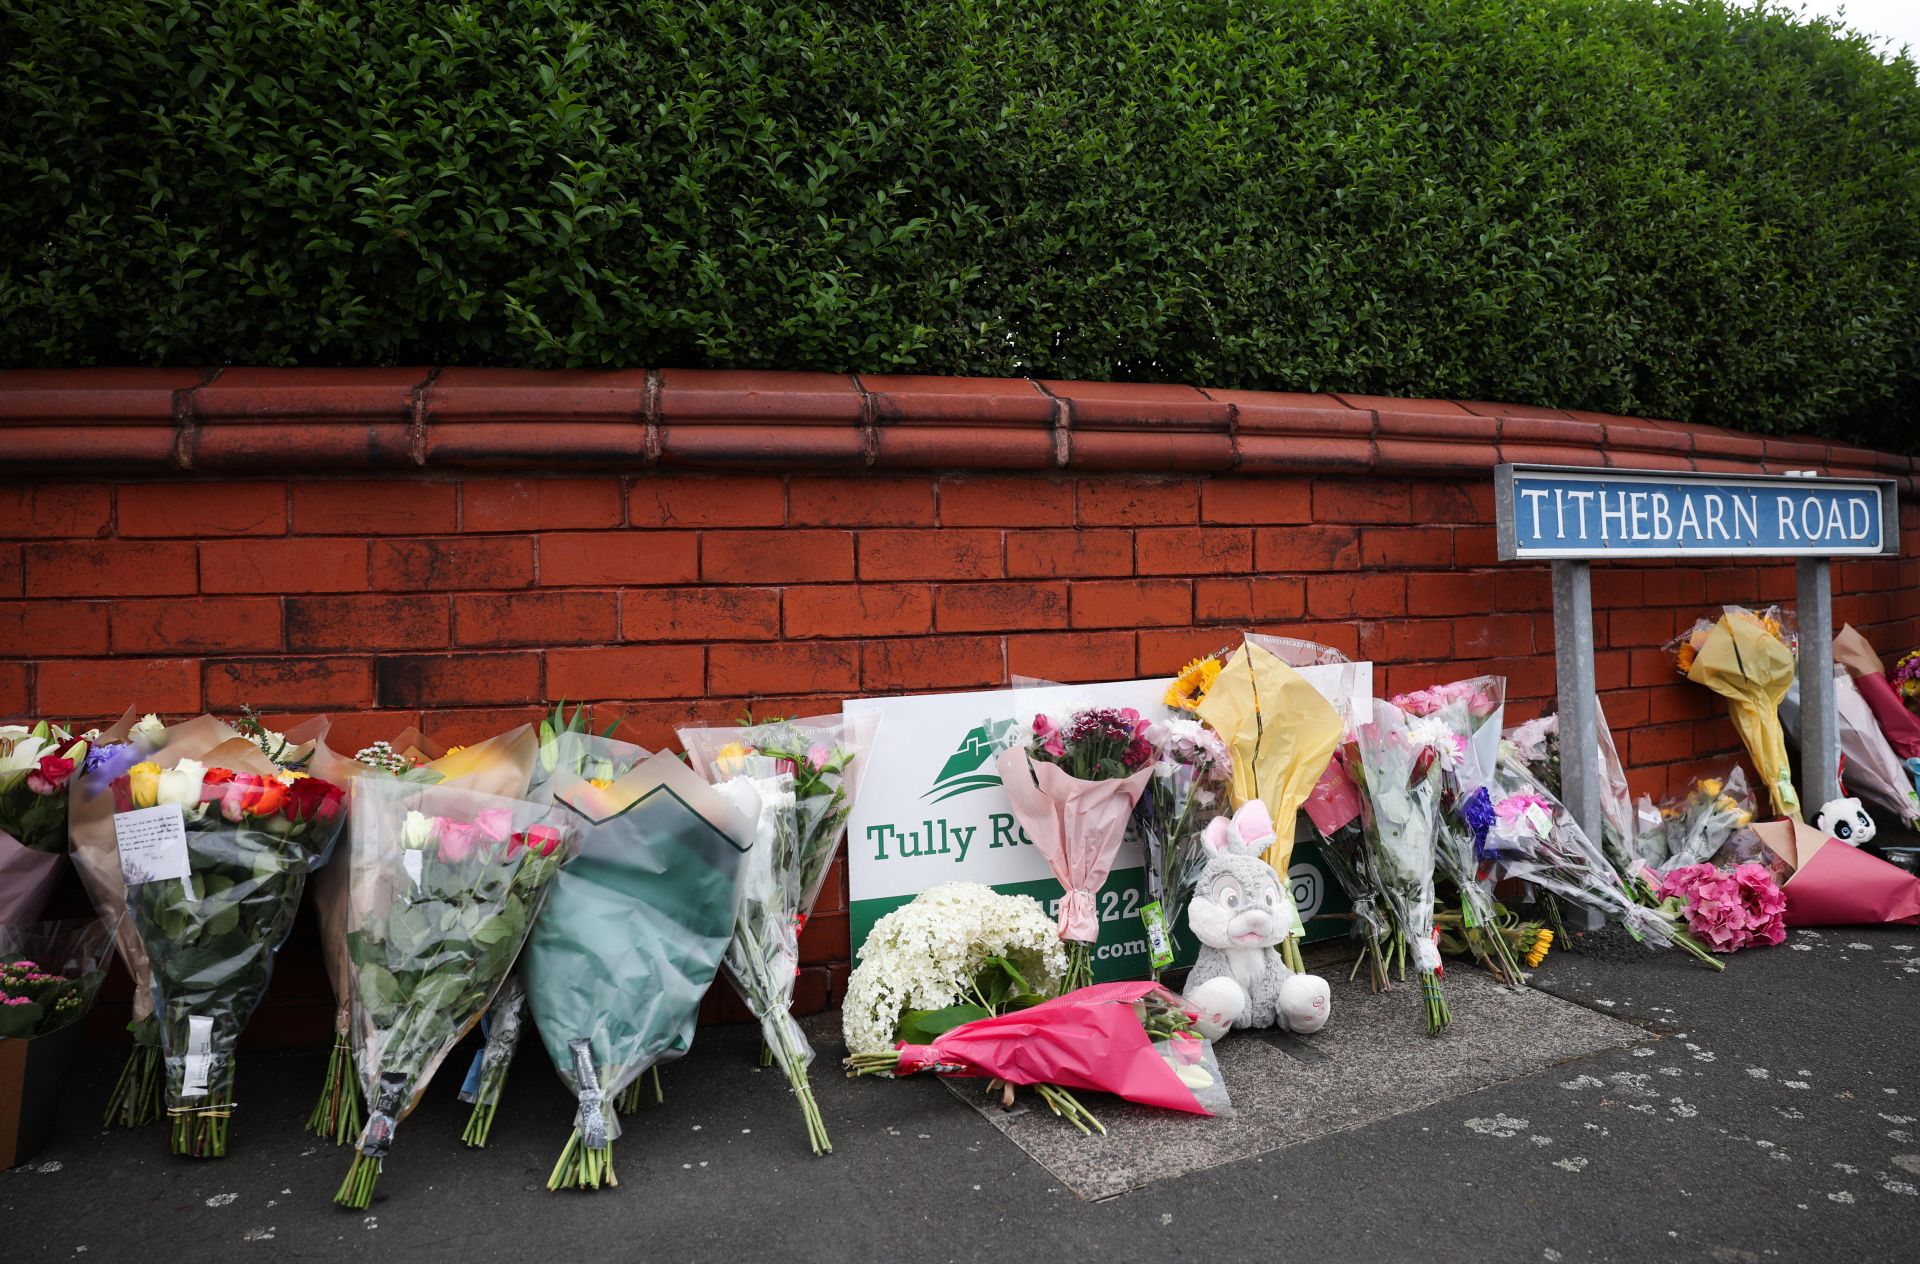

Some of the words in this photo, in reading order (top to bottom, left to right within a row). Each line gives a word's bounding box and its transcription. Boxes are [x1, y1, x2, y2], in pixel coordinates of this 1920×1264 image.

[1520, 488, 1758, 540] TITHEBARN
[1776, 495, 1870, 541] ROAD
[867, 818, 977, 862] Tully
